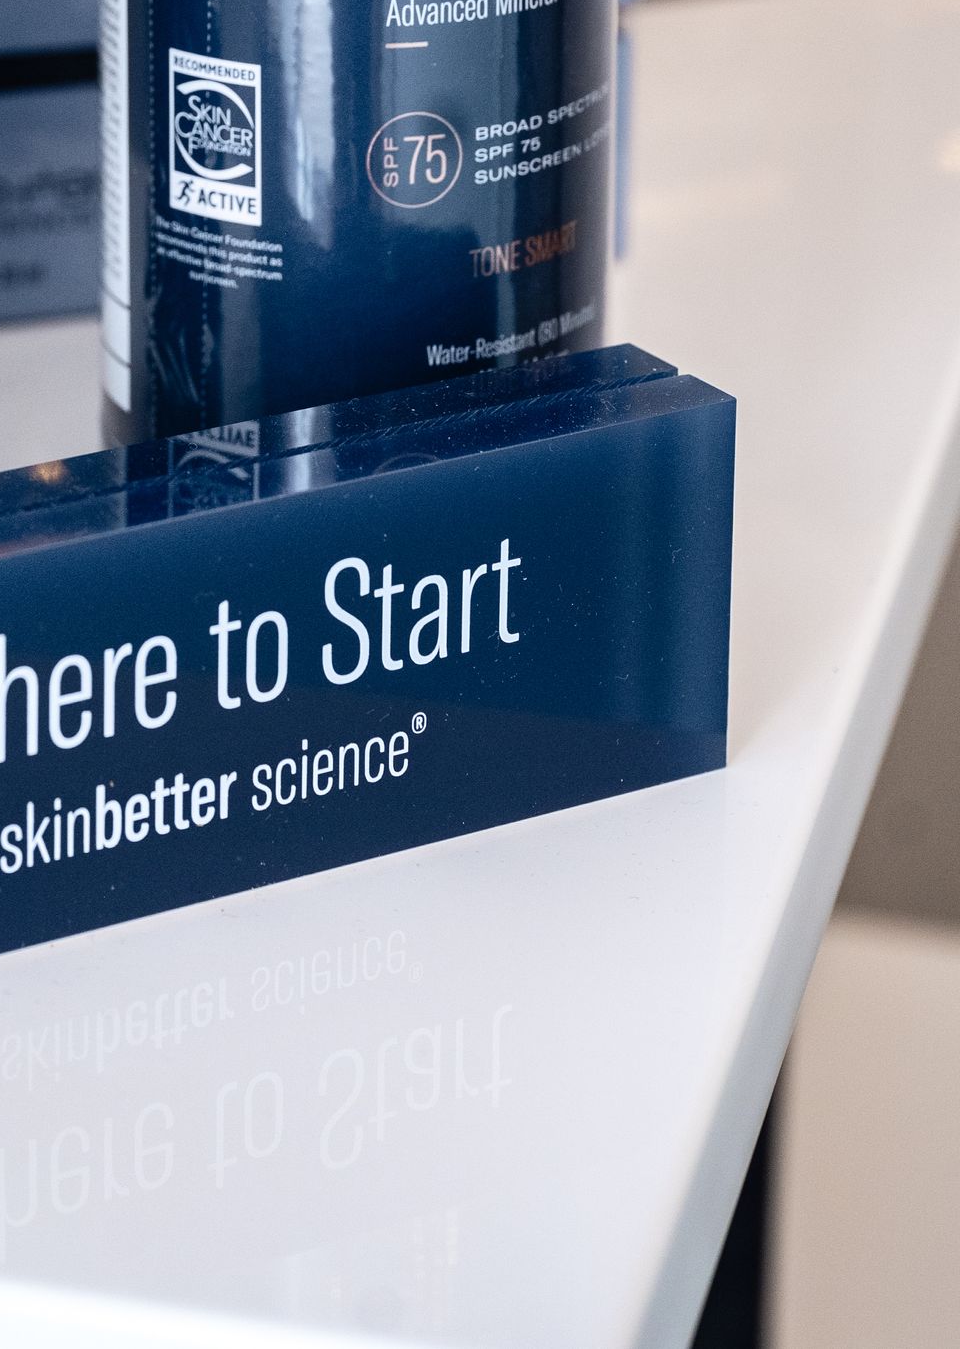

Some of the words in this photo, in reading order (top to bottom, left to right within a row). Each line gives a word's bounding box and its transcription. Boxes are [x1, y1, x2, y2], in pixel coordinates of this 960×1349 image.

[173, 55, 256, 82] RECOMMENDED
[188, 94, 232, 126] SKIN
[174, 111, 254, 149] CANCER
[475, 115, 543, 141] BROAD
[383, 136, 399, 188] SPF
[403, 133, 447, 185] 75
[474, 142, 514, 164] SPF
[520, 136, 542, 153] 75
[474, 144, 582, 186] SUNSCREEN
[198, 189, 257, 215] ACTIVE
[224, 234, 283, 253] Foundation
[228, 251, 268, 266] product
[269, 257, 283, 268] as
[468, 239, 520, 278] TONE
[208, 599, 289, 711] to
[321, 537, 522, 686] Start
[0, 770, 238, 875] skinbetter
[250, 711, 428, 812] science®
